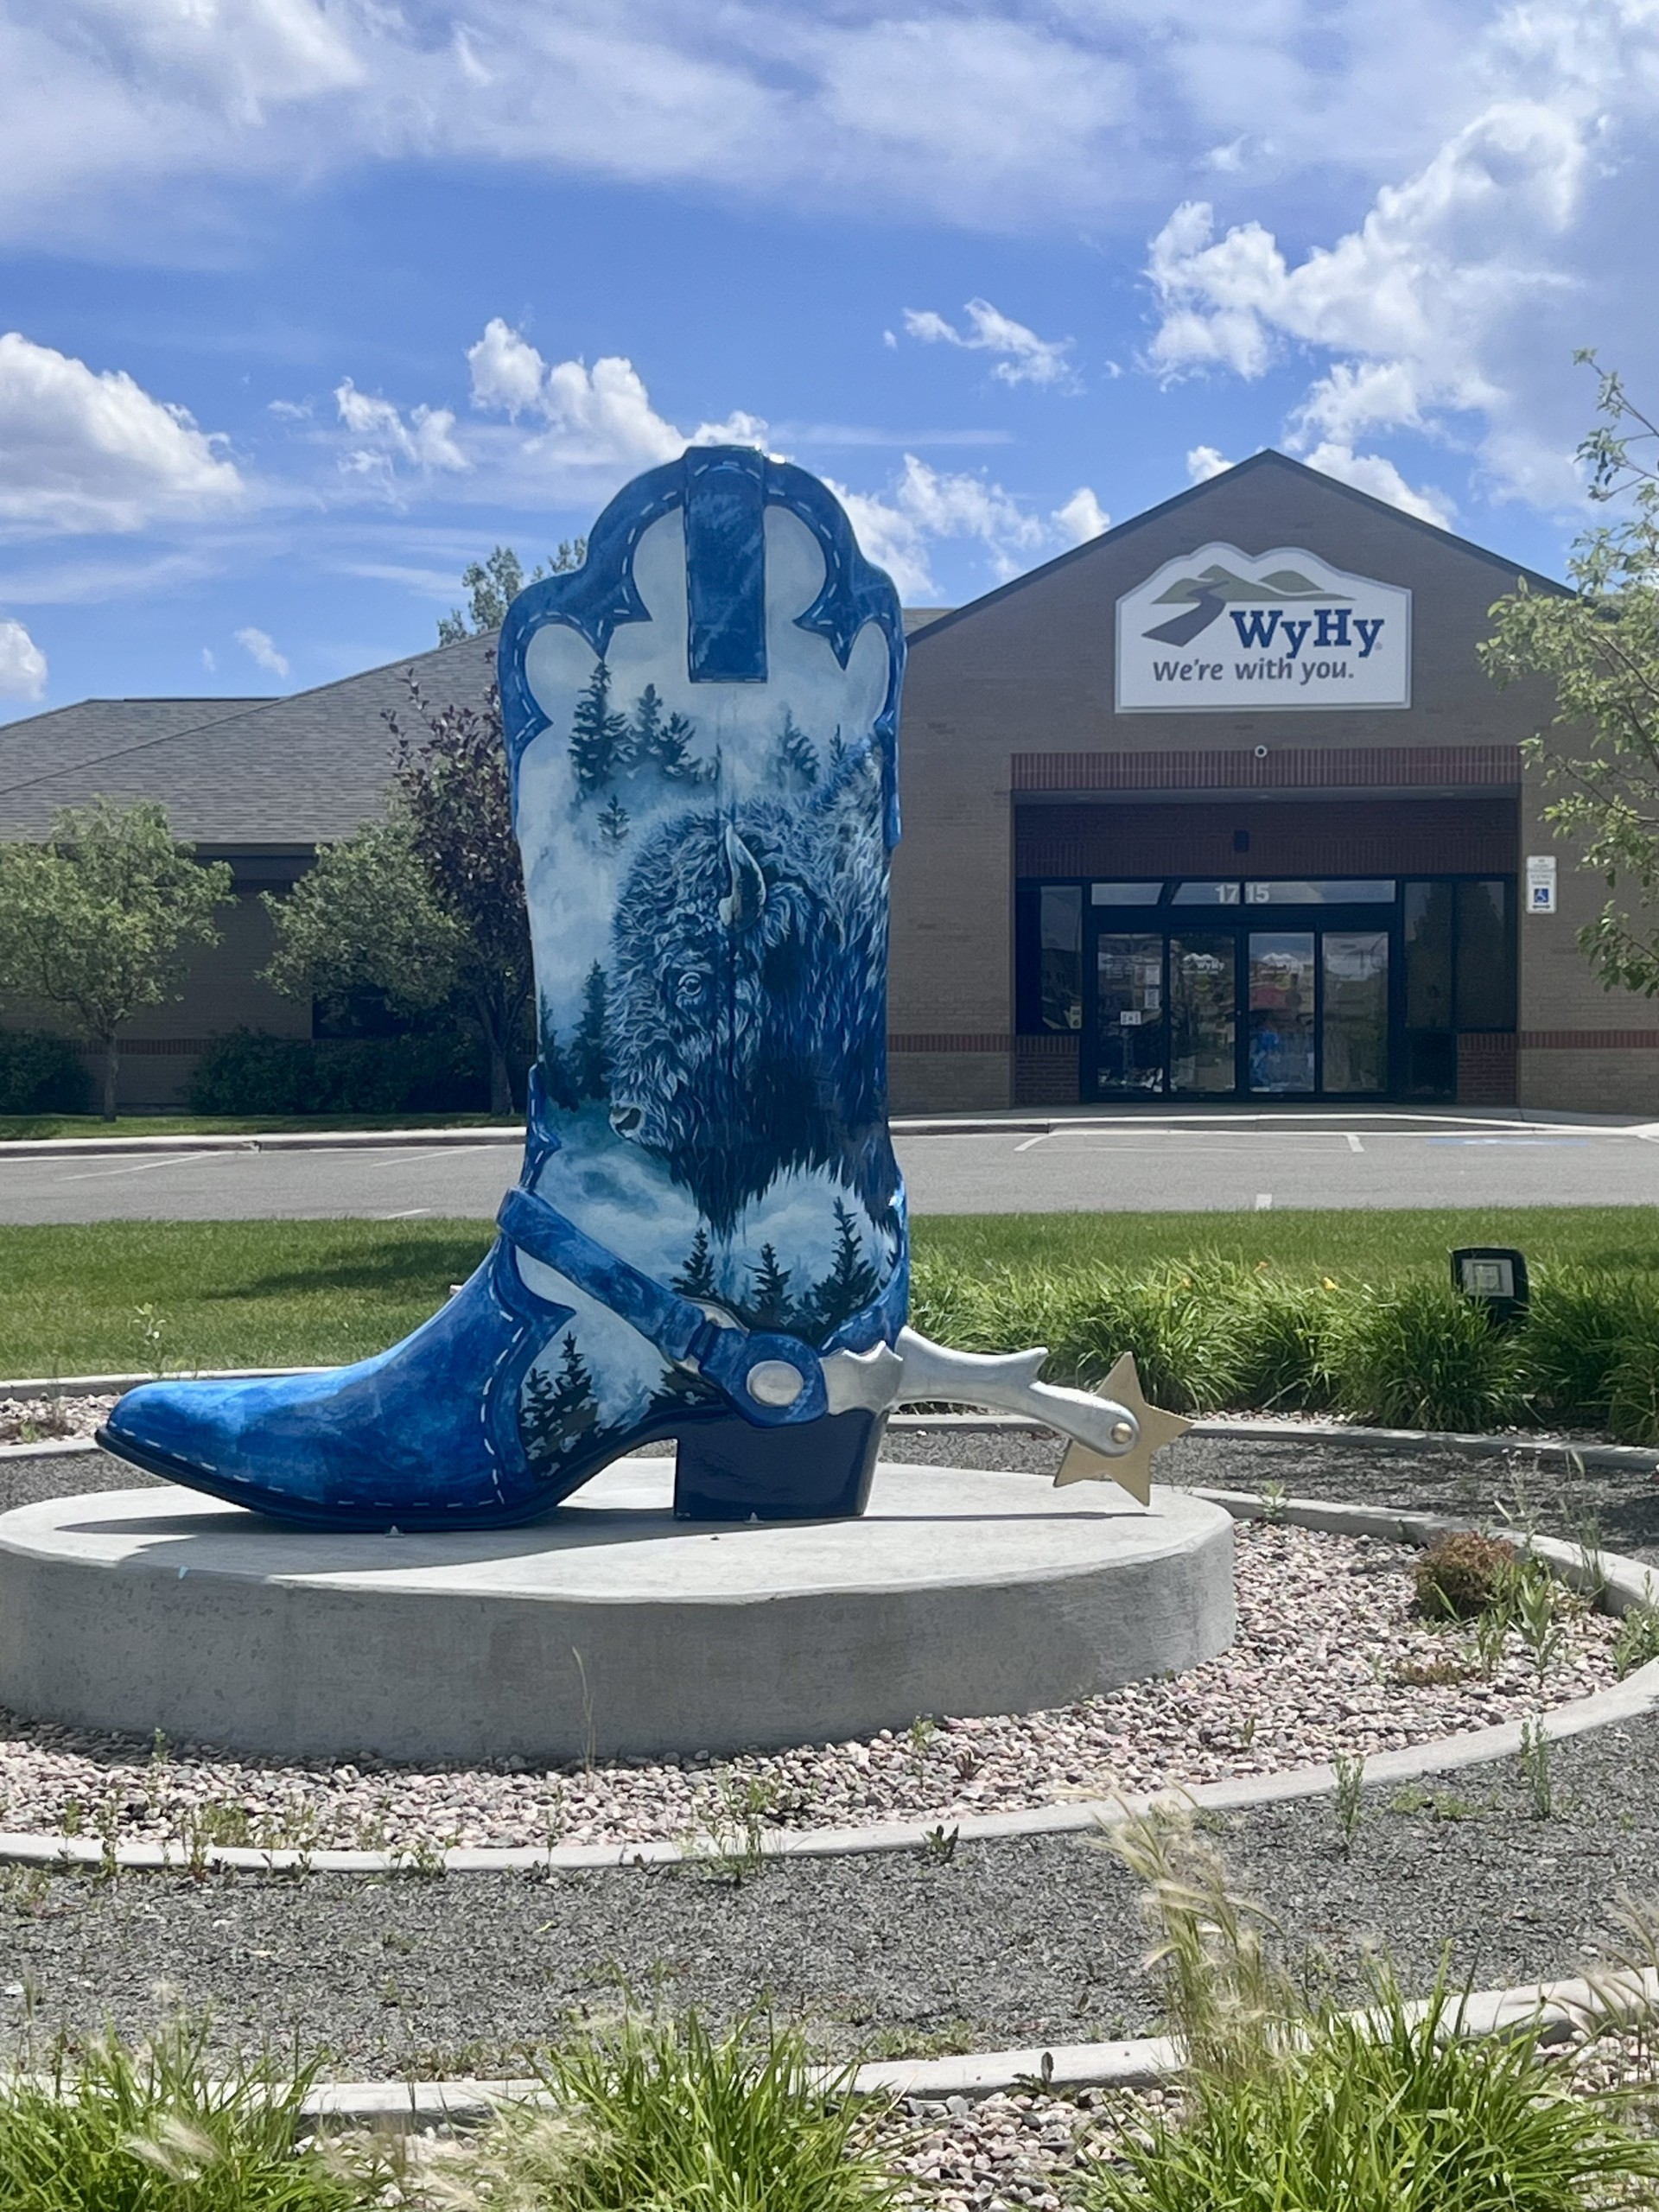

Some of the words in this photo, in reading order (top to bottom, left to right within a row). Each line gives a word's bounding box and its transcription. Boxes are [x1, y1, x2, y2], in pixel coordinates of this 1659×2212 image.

[1230, 609, 1385, 659] WyHy
[1154, 658, 1224, 682] We're
[1236, 658, 1293, 681] with
[1300, 661, 1355, 686] you.
[1215, 884, 1270, 904] 1715
